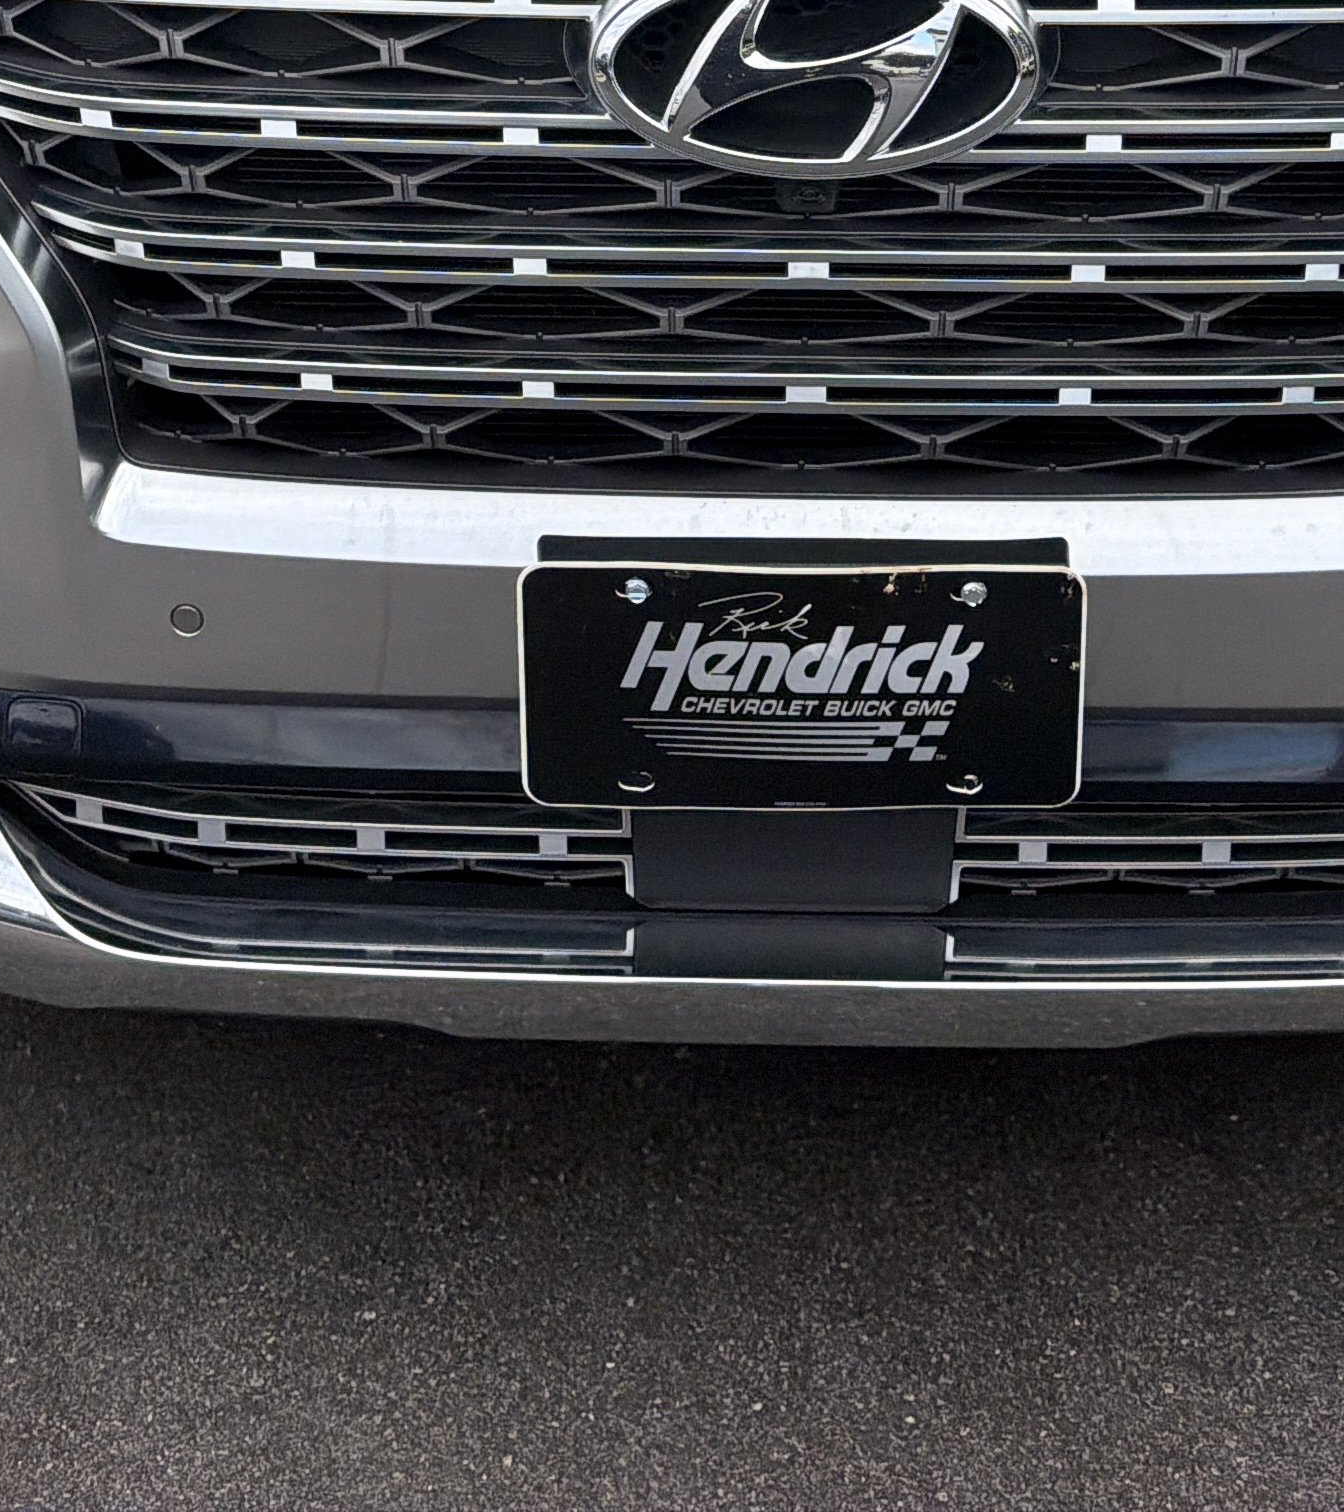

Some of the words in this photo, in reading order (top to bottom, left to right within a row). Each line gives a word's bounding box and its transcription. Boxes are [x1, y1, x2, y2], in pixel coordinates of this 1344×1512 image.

[697, 591, 813, 640] Rick
[620, 621, 985, 711] Hendrick
[681, 696, 820, 717] CHEVROLET
[822, 698, 898, 717] BUICK
[902, 699, 956, 717] GMC
